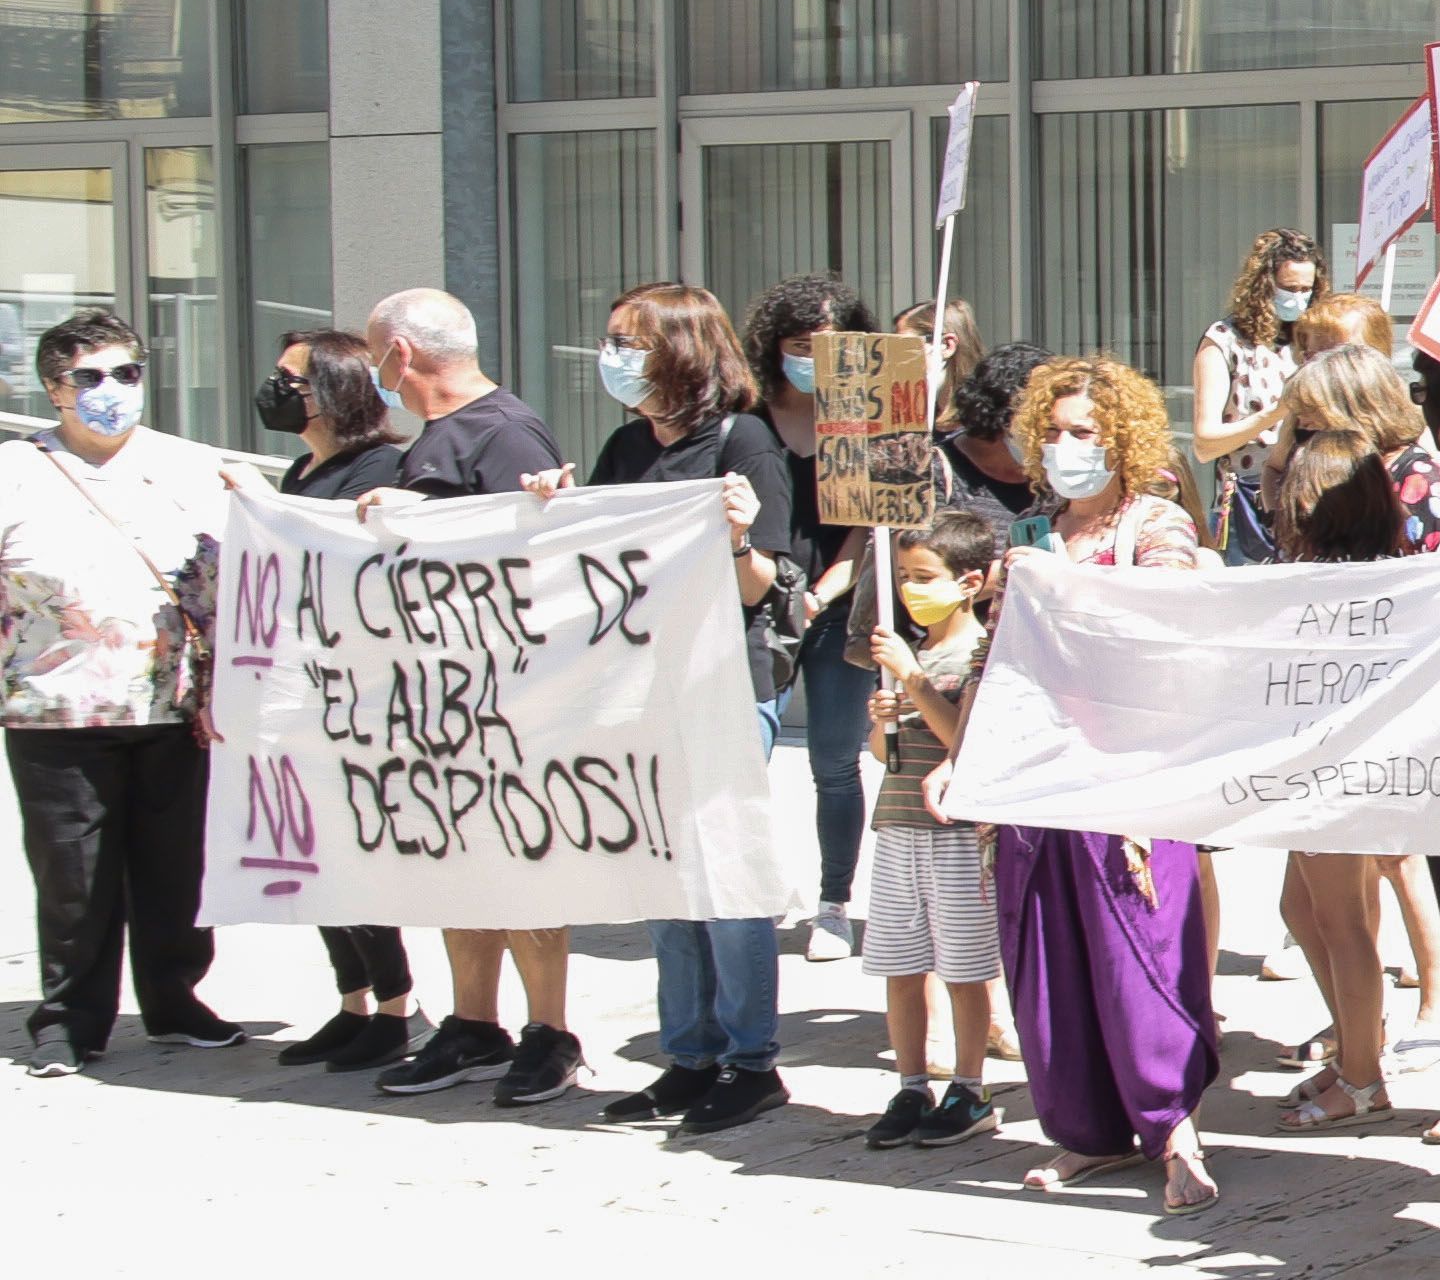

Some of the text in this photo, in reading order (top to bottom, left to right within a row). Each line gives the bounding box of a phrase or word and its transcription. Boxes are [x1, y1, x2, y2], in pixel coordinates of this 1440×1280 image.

[837, 336, 884, 377] LOS
[891, 379, 927, 425] NO
[818, 435, 868, 481] SON
[235, 550, 281, 648] NO
[298, 550, 341, 648] AL
[577, 549, 650, 646] DE
[1296, 597, 1394, 637] AYER
[246, 751, 673, 862] NO DESPIDOS!!
